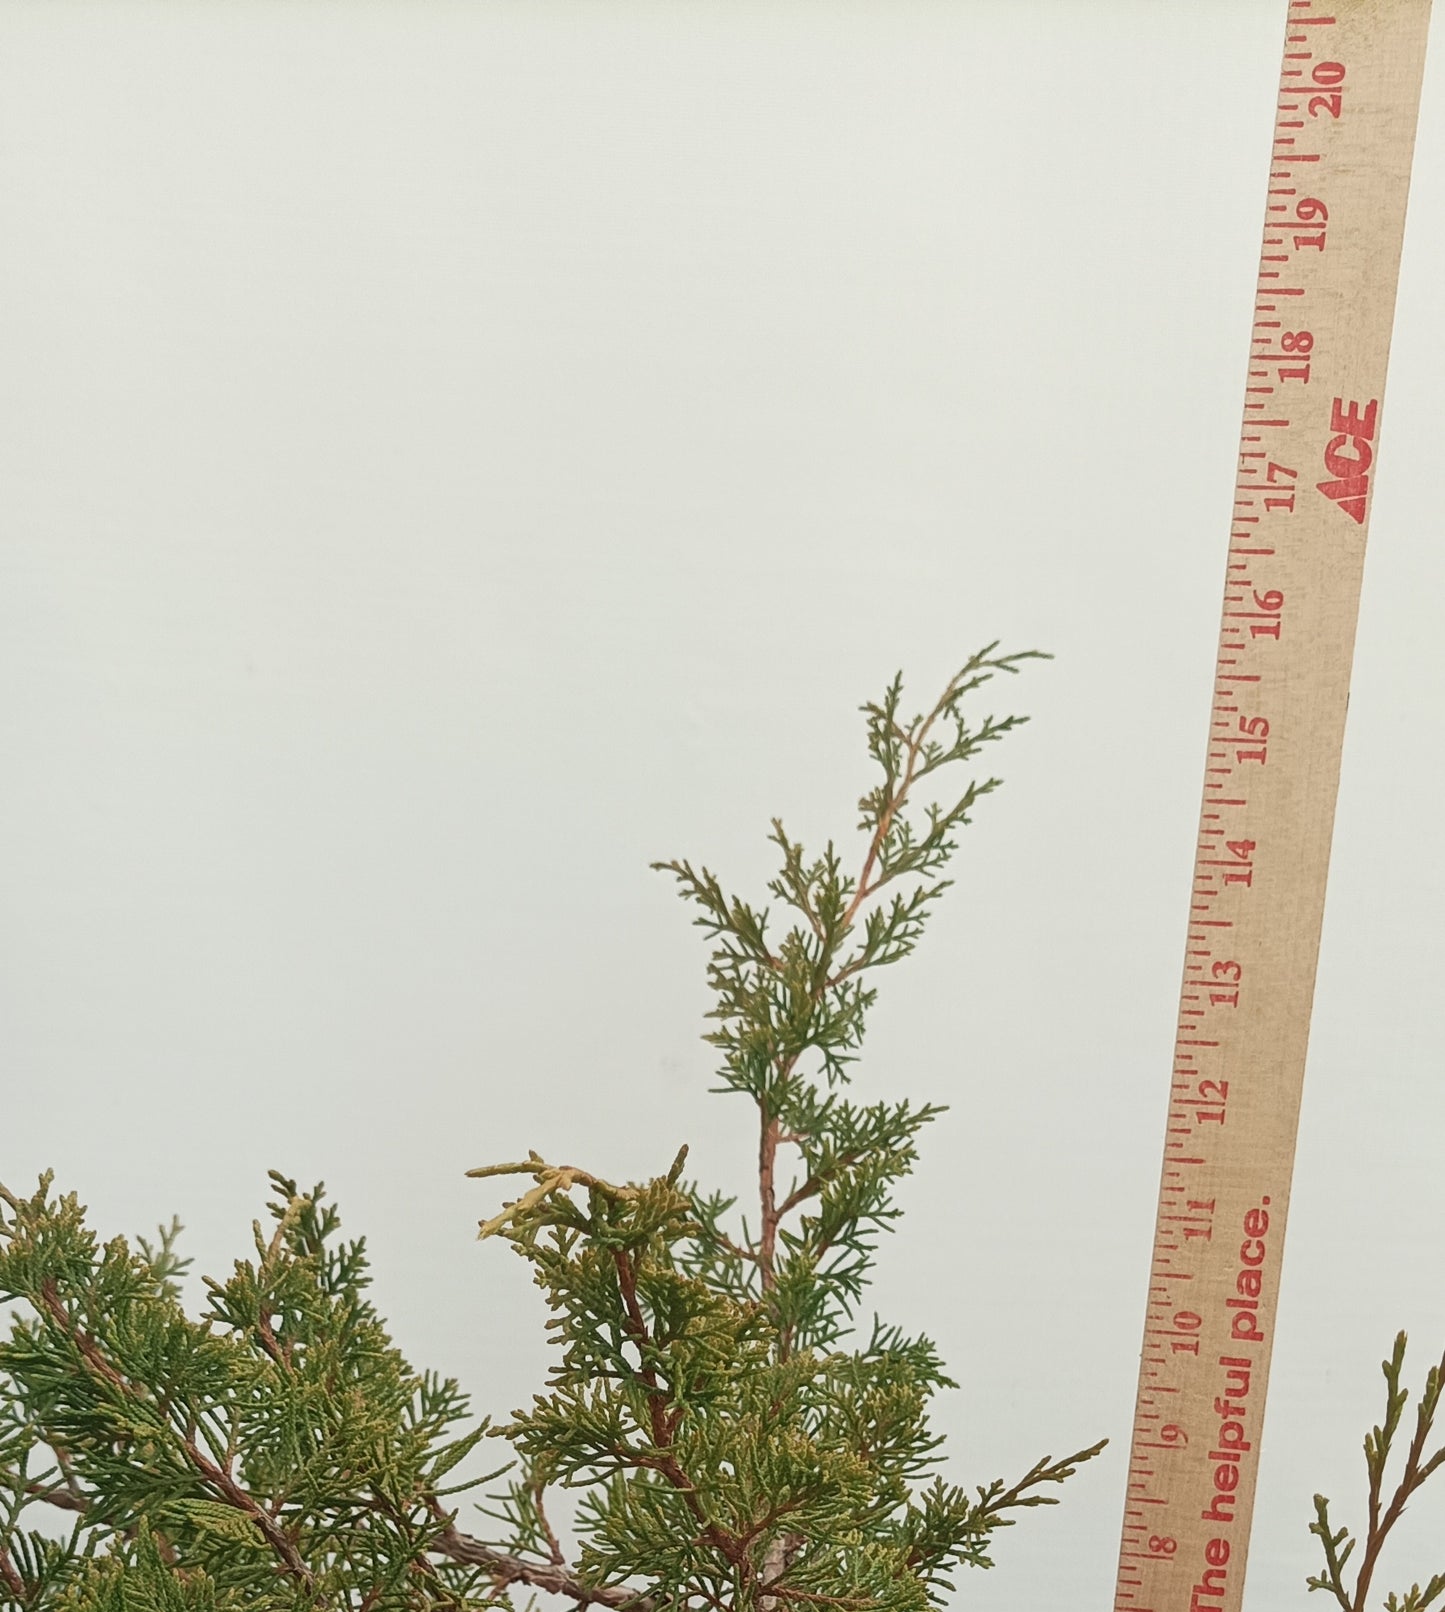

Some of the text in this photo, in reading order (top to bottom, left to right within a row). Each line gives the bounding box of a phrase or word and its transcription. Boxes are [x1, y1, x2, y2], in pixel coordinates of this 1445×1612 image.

[1308, 61, 1346, 119] 20
[1293, 197, 1329, 252] 19
[1278, 330, 1314, 385] 18
[1316, 397, 1378, 525] ACE
[1264, 461, 1298, 513] 17
[1249, 589, 1284, 641] 16
[1236, 715, 1270, 766] 15
[1222, 838, 1257, 888] 14
[1209, 960, 1243, 1009] 13
[1196, 1079, 1229, 1126] 12
[1182, 1197, 1216, 1242] 11
[1225, 1195, 1271, 1342] place.
[1171, 1310, 1203, 1357] 10
[1160, 1423, 1189, 1444] 9
[1201, 1356, 1253, 1523] helpful
[1148, 1535, 1178, 1555] 8
